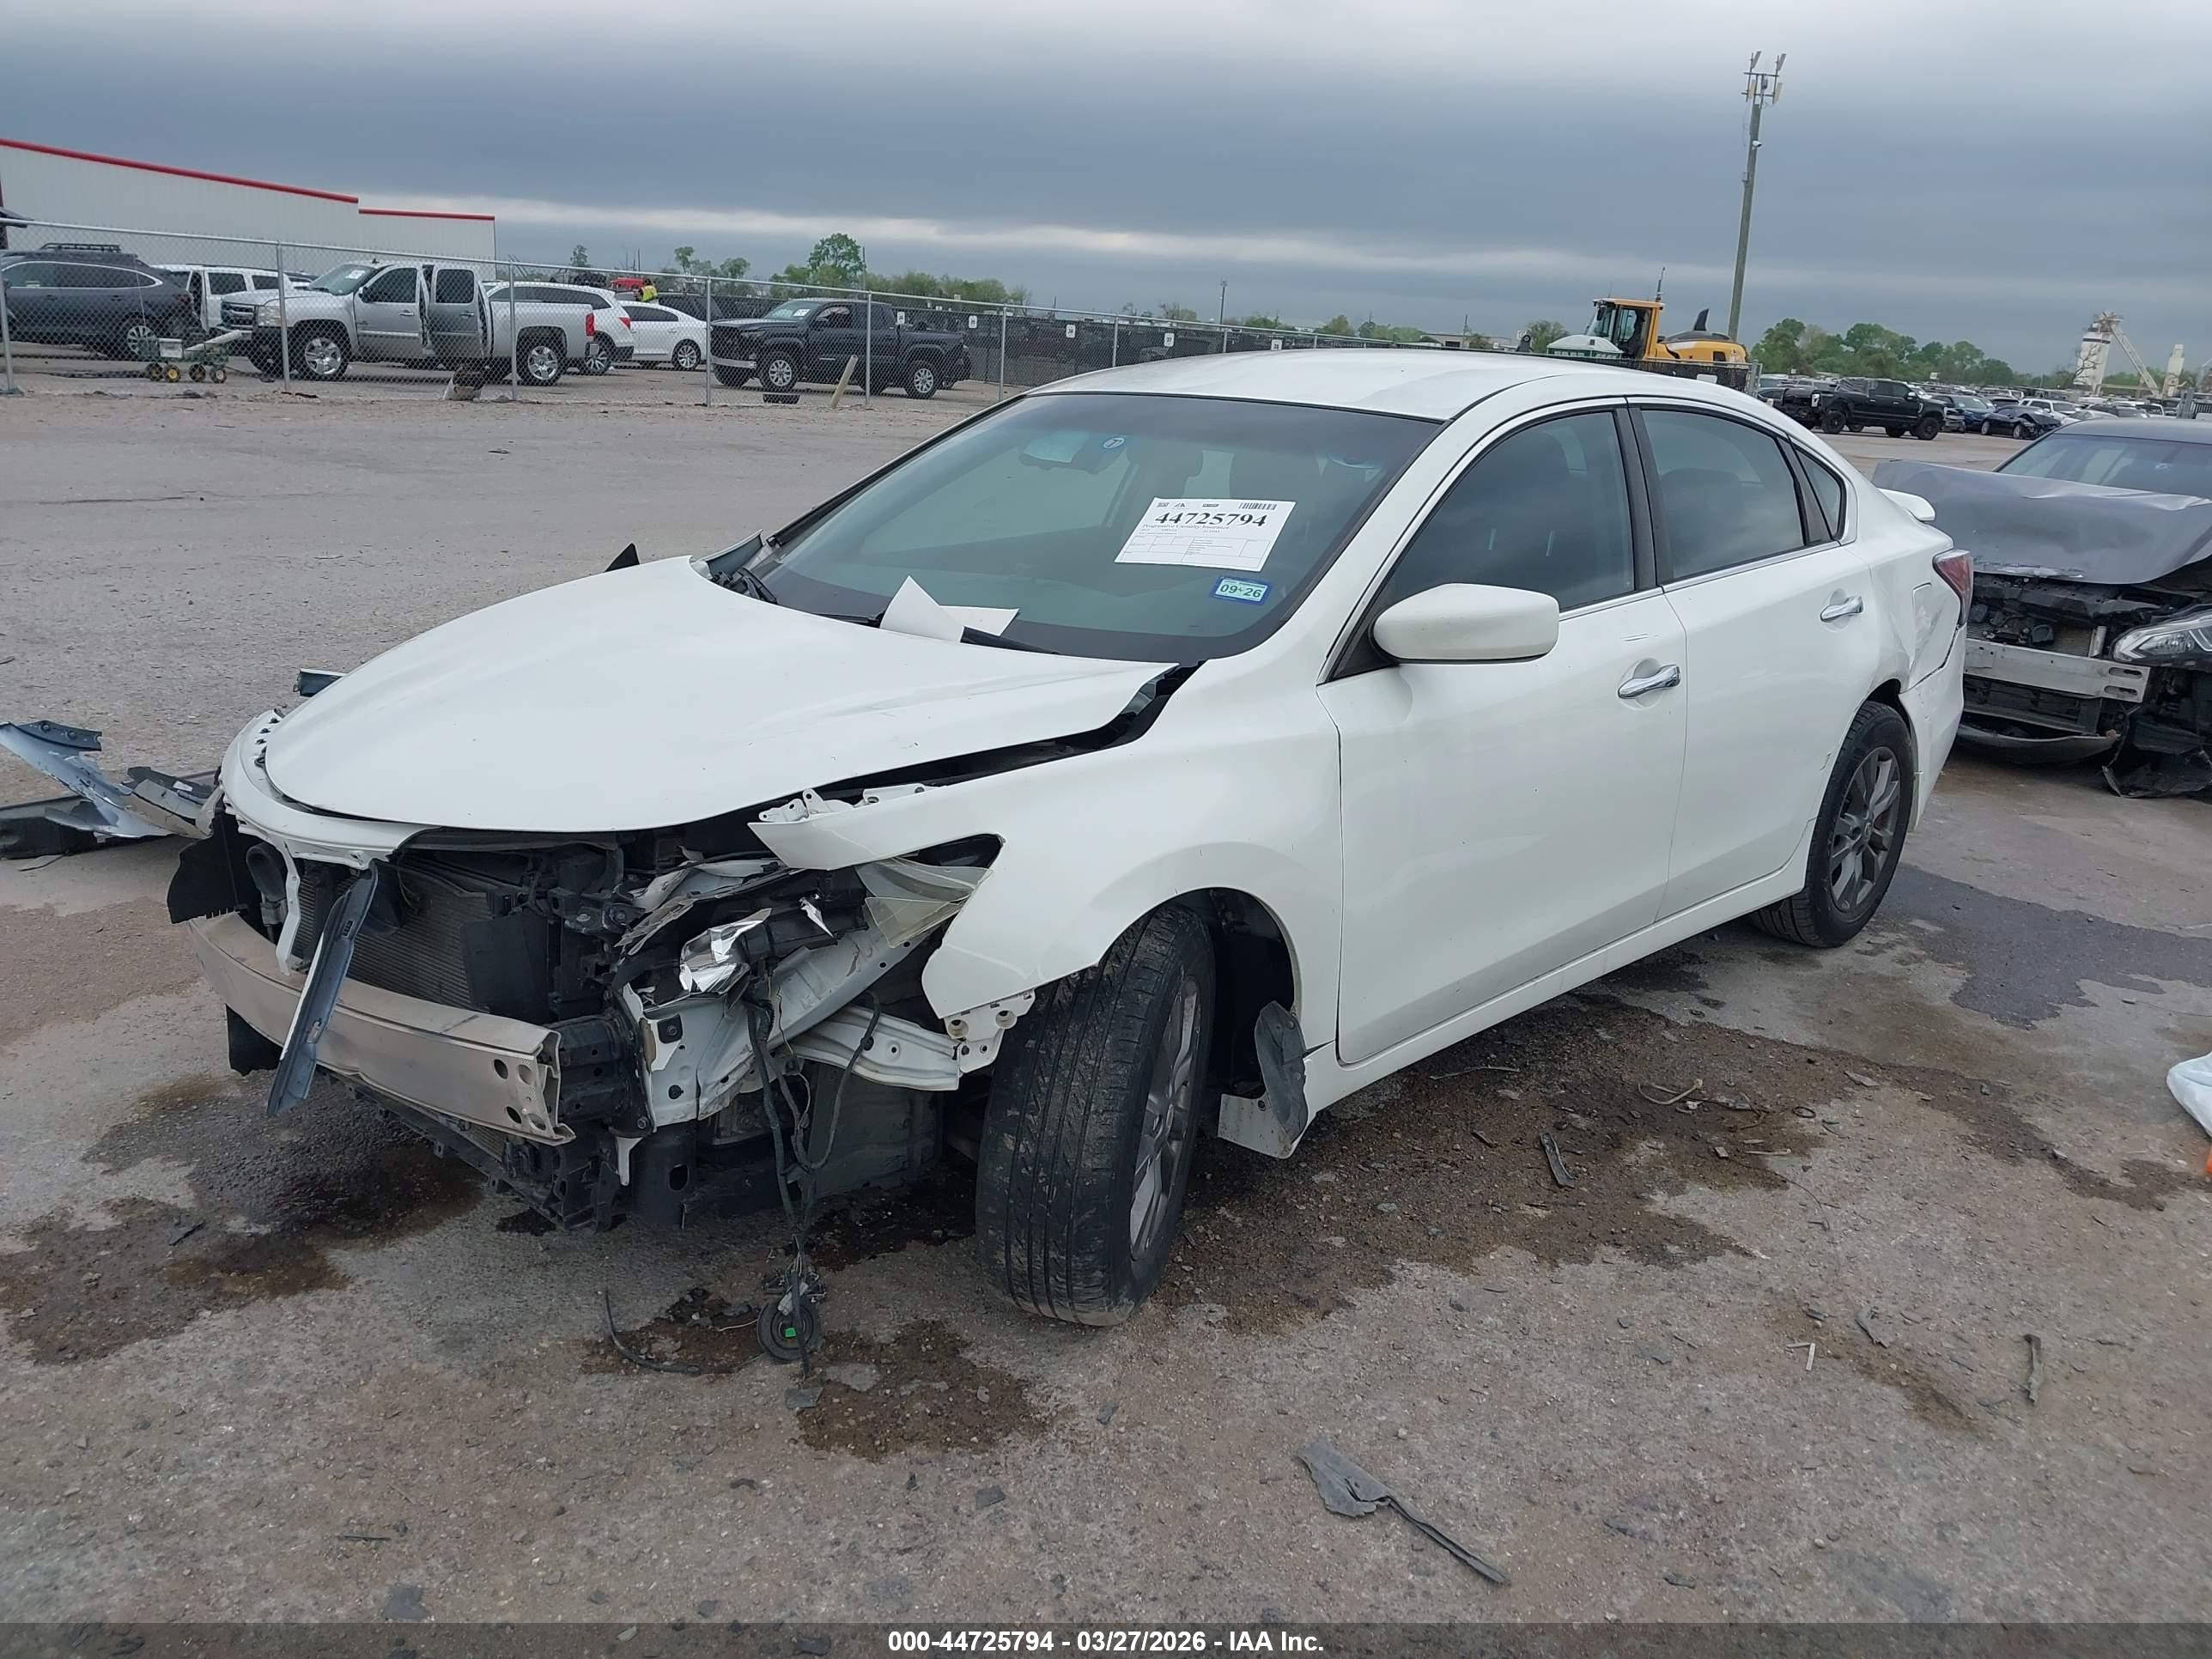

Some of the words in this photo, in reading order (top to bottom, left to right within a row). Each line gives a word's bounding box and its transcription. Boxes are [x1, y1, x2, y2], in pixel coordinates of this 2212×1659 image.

[1155, 512, 1267, 526] 44725794
[1219, 584, 1238, 594] 09
[1243, 587, 1262, 598] 26
